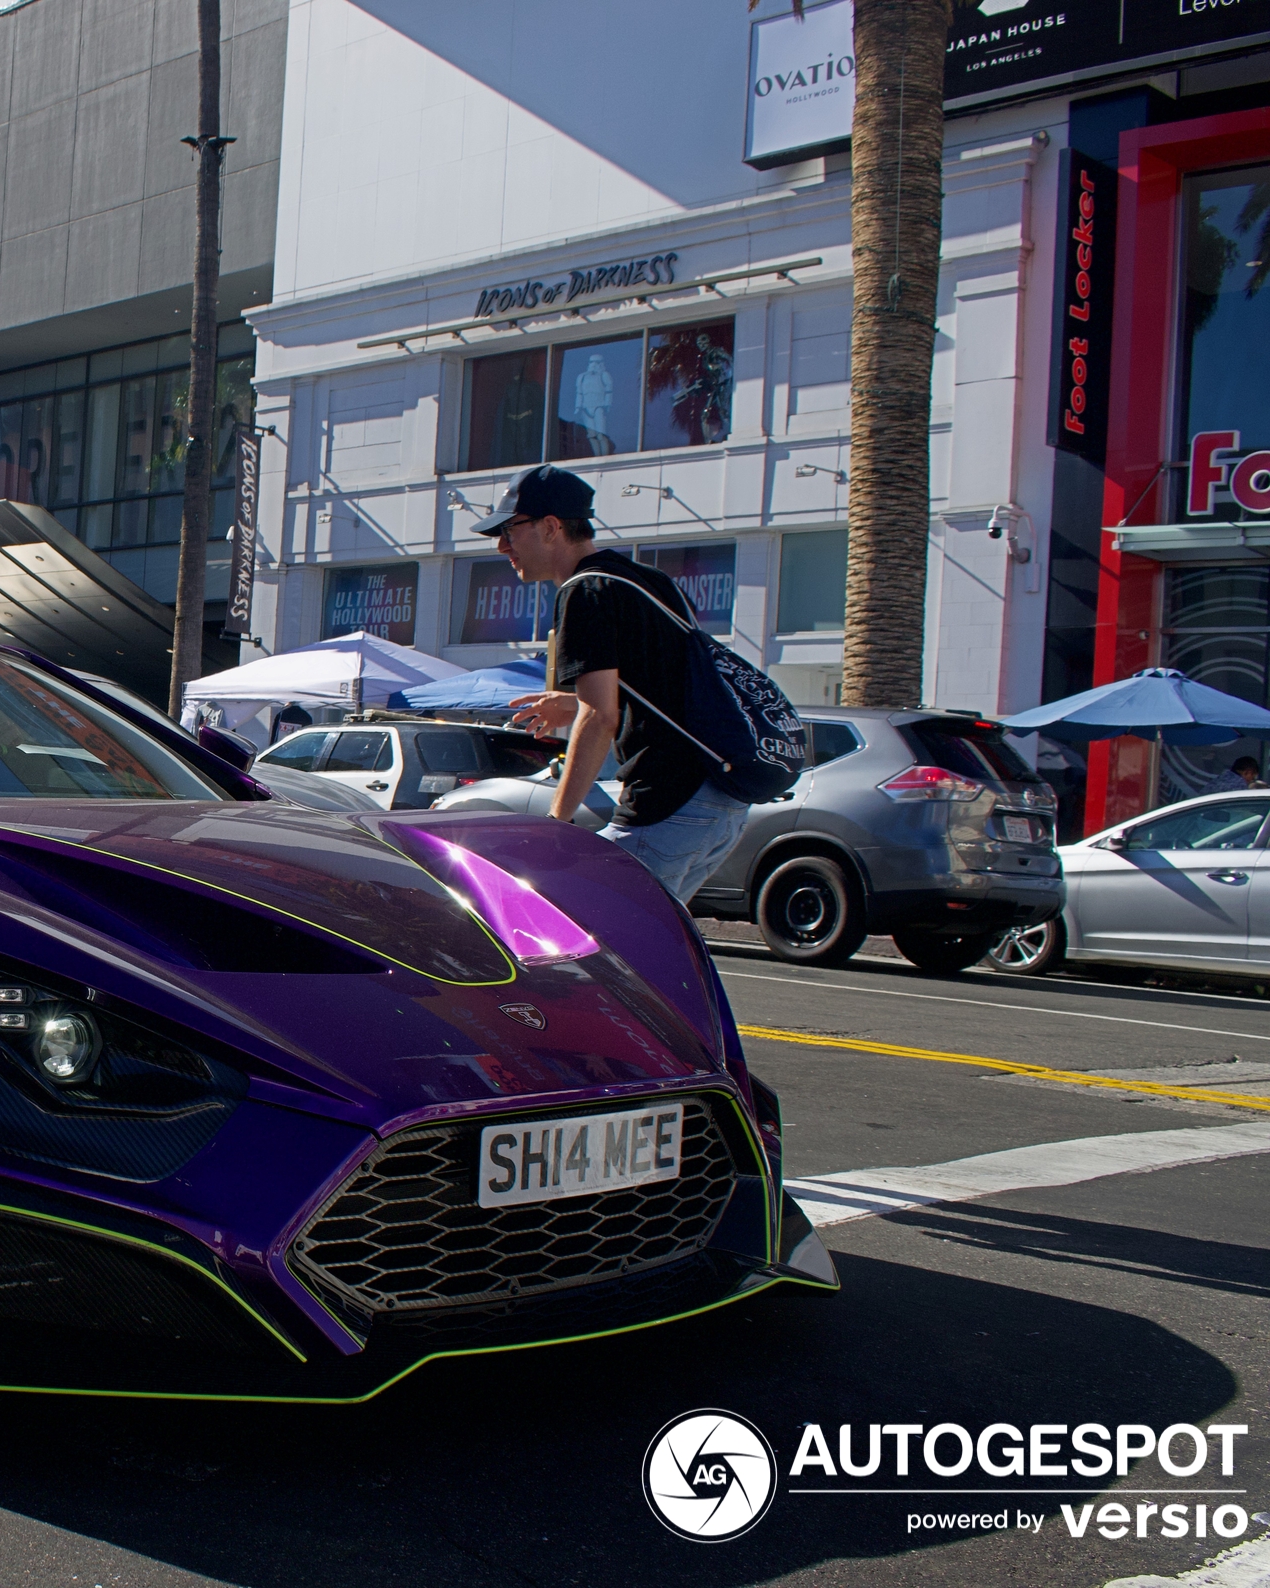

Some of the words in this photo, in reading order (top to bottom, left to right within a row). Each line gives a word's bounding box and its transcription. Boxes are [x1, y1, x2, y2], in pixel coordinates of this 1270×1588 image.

[945, 29, 1002, 52] JAPAN
[1007, 13, 1067, 37] HOUSE
[965, 60, 988, 73] LOS
[990, 47, 1043, 67] ANGELES
[785, 86, 841, 105] HOLLYWOOD
[1070, 170, 1095, 321] Locker
[474, 279, 544, 319] ICONS
[565, 252, 679, 303] DARKNESS
[1064, 337, 1089, 434] Foot
[240, 435, 258, 504] ICONS
[230, 518, 256, 621] DARKNESS
[366, 574, 388, 589] THE
[331, 604, 412, 626] HOLLYWOOD
[335, 586, 413, 608] ULTIMATE
[474, 583, 548, 620] HEROES
[603, 1111, 678, 1178] MEE
